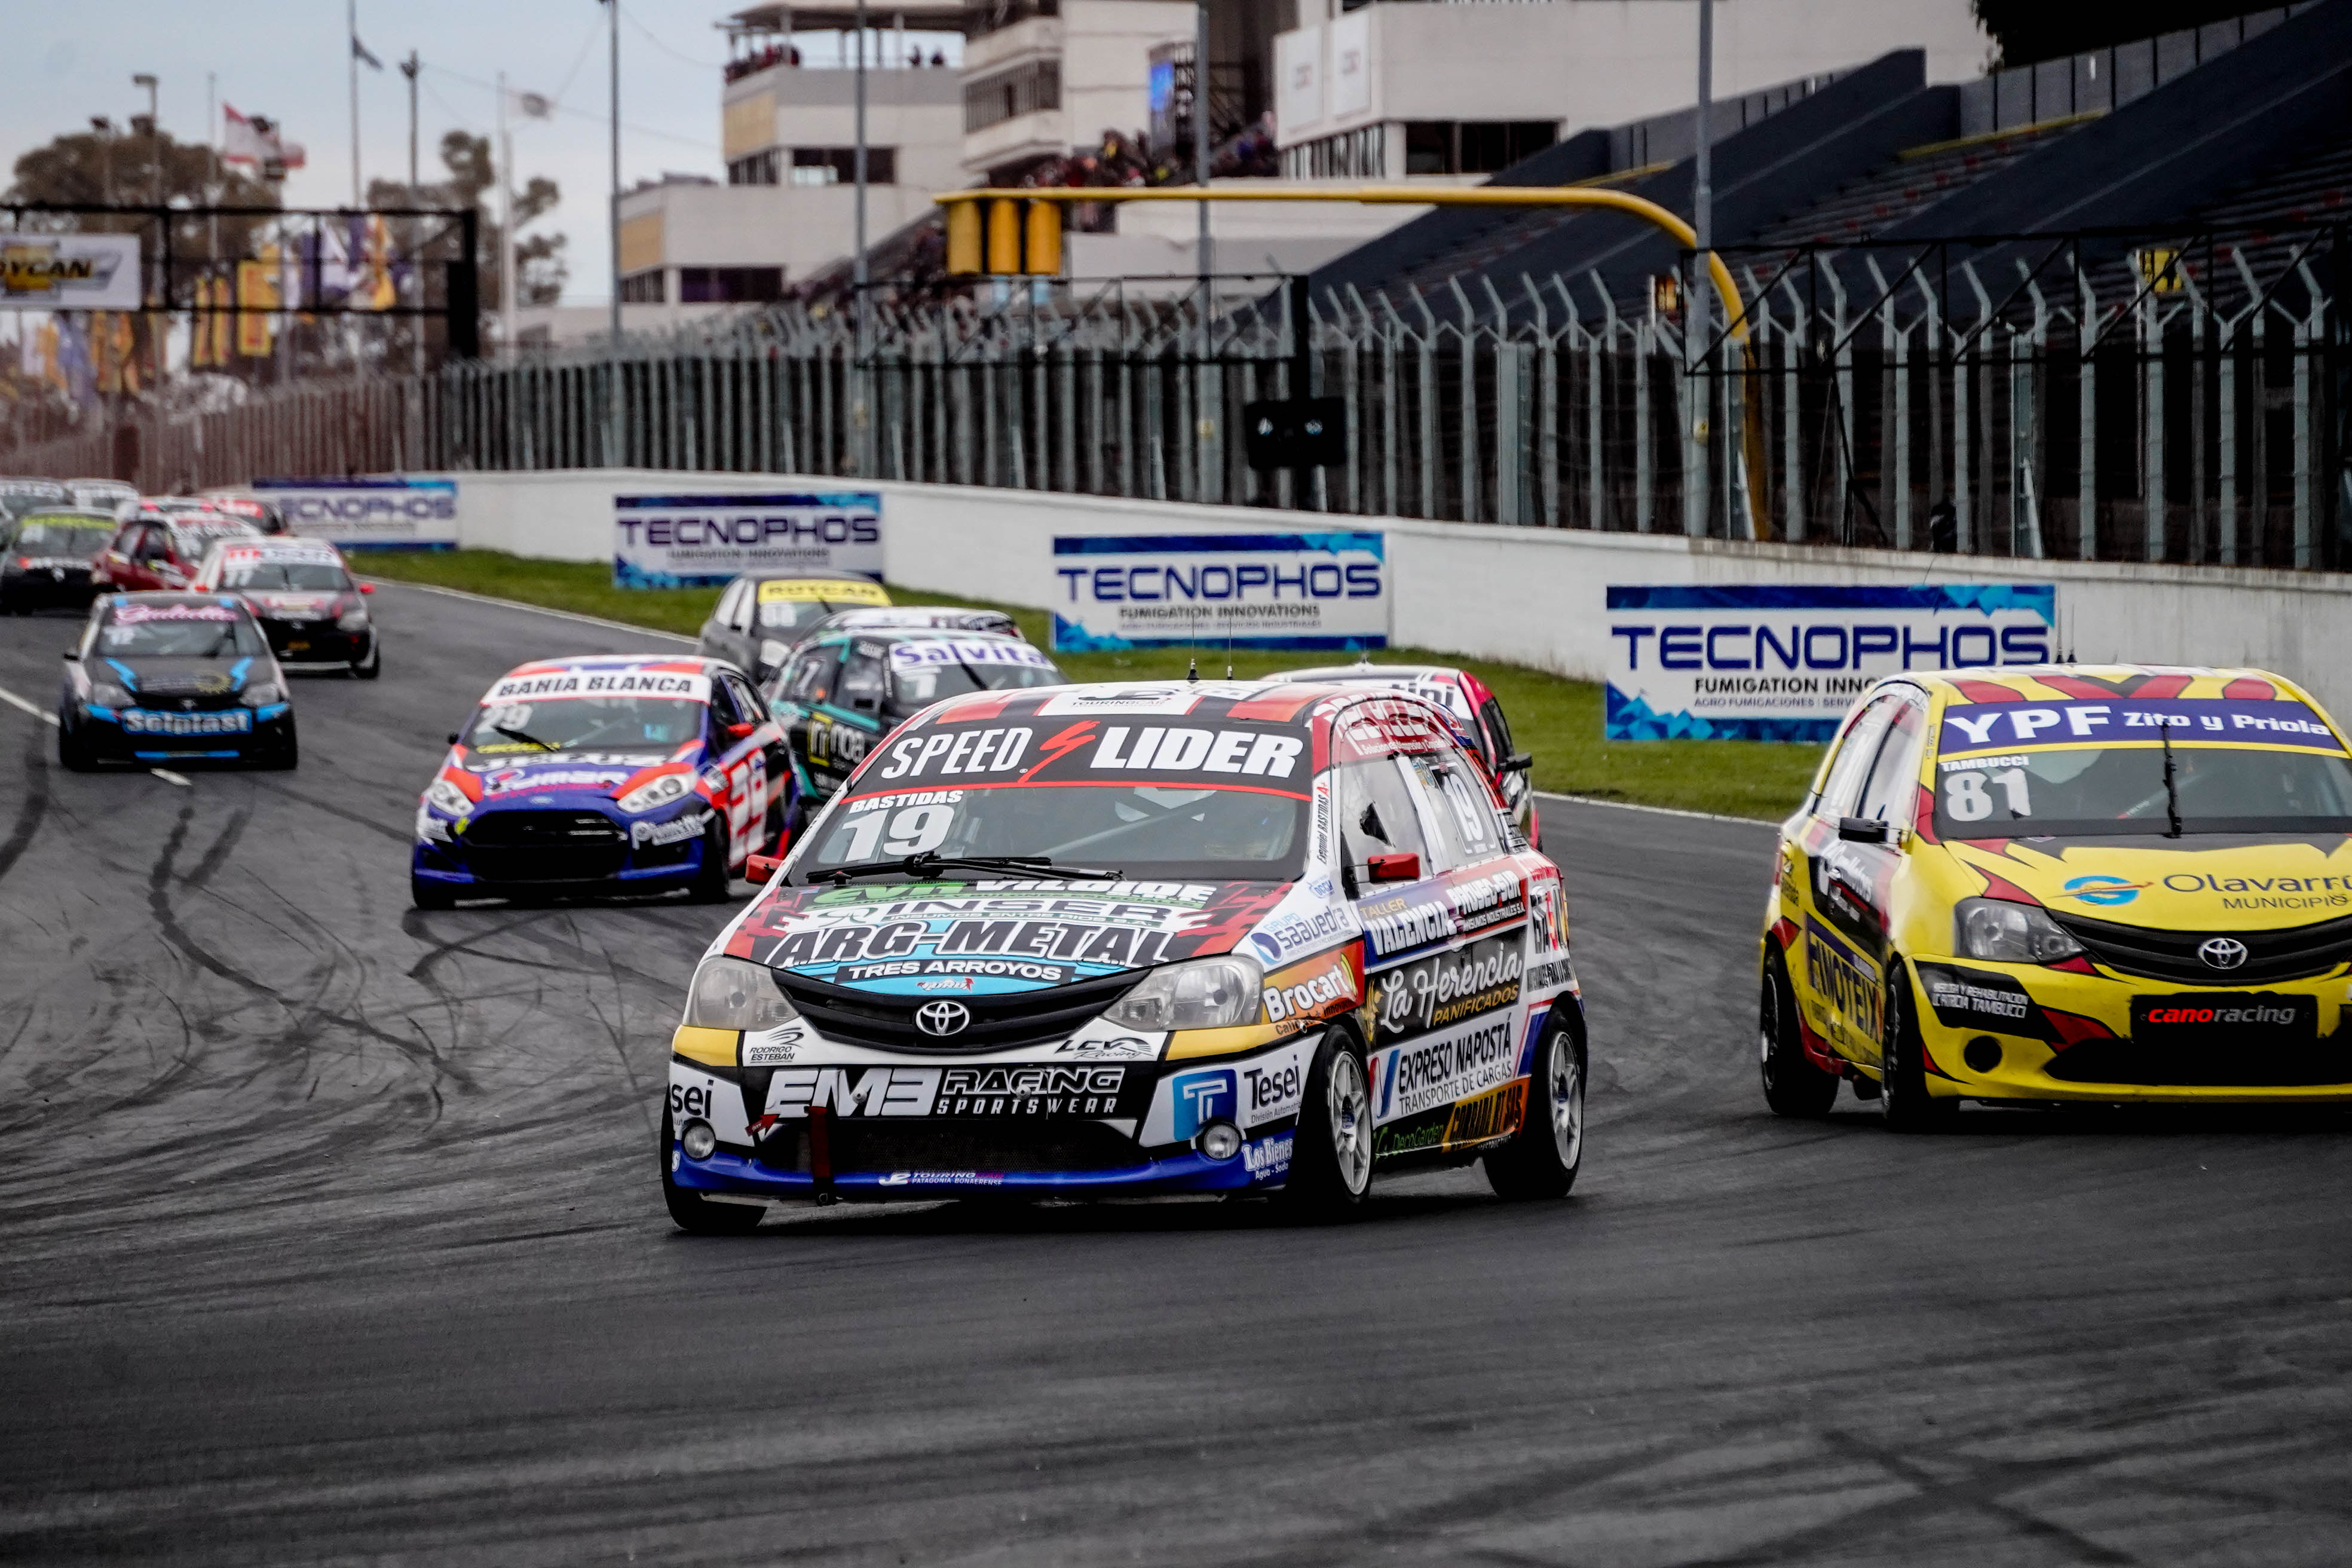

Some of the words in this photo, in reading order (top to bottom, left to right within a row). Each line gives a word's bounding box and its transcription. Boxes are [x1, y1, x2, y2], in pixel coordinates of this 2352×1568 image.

[618, 517, 878, 545] TECNOPHOS
[1057, 564, 1383, 601] TECNOPHOS
[1120, 605, 1212, 618] FUMIGATION
[1217, 604, 1321, 618] INNOVATIONS
[1611, 624, 2050, 670] TECNOPHOS
[498, 677, 578, 697] BAHIA
[587, 676, 693, 693] BLANCA
[1695, 677, 1818, 694] FUMIGATION
[1693, 697, 1726, 708] AGRO
[1729, 697, 1815, 708] FUMIGACIONES
[474, 704, 534, 734] 29
[1943, 706, 2112, 744] YPF
[2122, 712, 2191, 727] Zito
[2200, 715, 2224, 731] y
[2231, 713, 2333, 736] Priola
[881, 727, 1034, 779] SPEED
[1089, 726, 1304, 778] LIDER
[1940, 755, 2029, 772] TAMBUCCI
[848, 790, 964, 814] BASTIDAS
[1316, 782, 1330, 798] A+
[1944, 768, 2032, 822] 81
[1318, 795, 1330, 834] BASTIDAS
[1443, 774, 1484, 841] 19
[841, 804, 956, 862] 19
[1359, 898, 1407, 918] TALLER
[1263, 912, 1301, 933] GRUPO
[1274, 905, 1350, 950] saavedra
[1365, 901, 1450, 956] VALENCIA
[766, 919, 1174, 969] ARG-METAL
[849, 963, 920, 980] TRES
[924, 960, 1062, 981] ARROYOS
[1263, 964, 1350, 1023] Brocart
[1380, 969, 1413, 1033] La
[1413, 942, 1523, 1029] Herencia
[1966, 985, 2029, 1005] REHABILITACION
[1434, 984, 1520, 1026] PANIFICADOS
[1971, 997, 2027, 1018] TAMBUCCI
[2148, 1004, 2296, 1025] canoracing
[751, 1053, 795, 1061] ESTEBAN
[1074, 1050, 1141, 1059] Racing
[1398, 1040, 1453, 1095] EXPRESO
[1455, 1012, 1512, 1075] NAPOSTÁ
[942, 1067, 1126, 1095] RACING
[1244, 1054, 1301, 1110] Tesei
[1399, 1084, 1460, 1116] TRANSPORTE
[1462, 1076, 1475, 1091] DE
[1476, 1061, 1512, 1088] CARGAS
[936, 1098, 1118, 1114] SPORTSWEAR
[1251, 1110, 1273, 1124] División
[1242, 1144, 1264, 1172] Los
[1255, 1168, 1271, 1181] Agua
[1275, 1162, 1289, 1174] Soda
